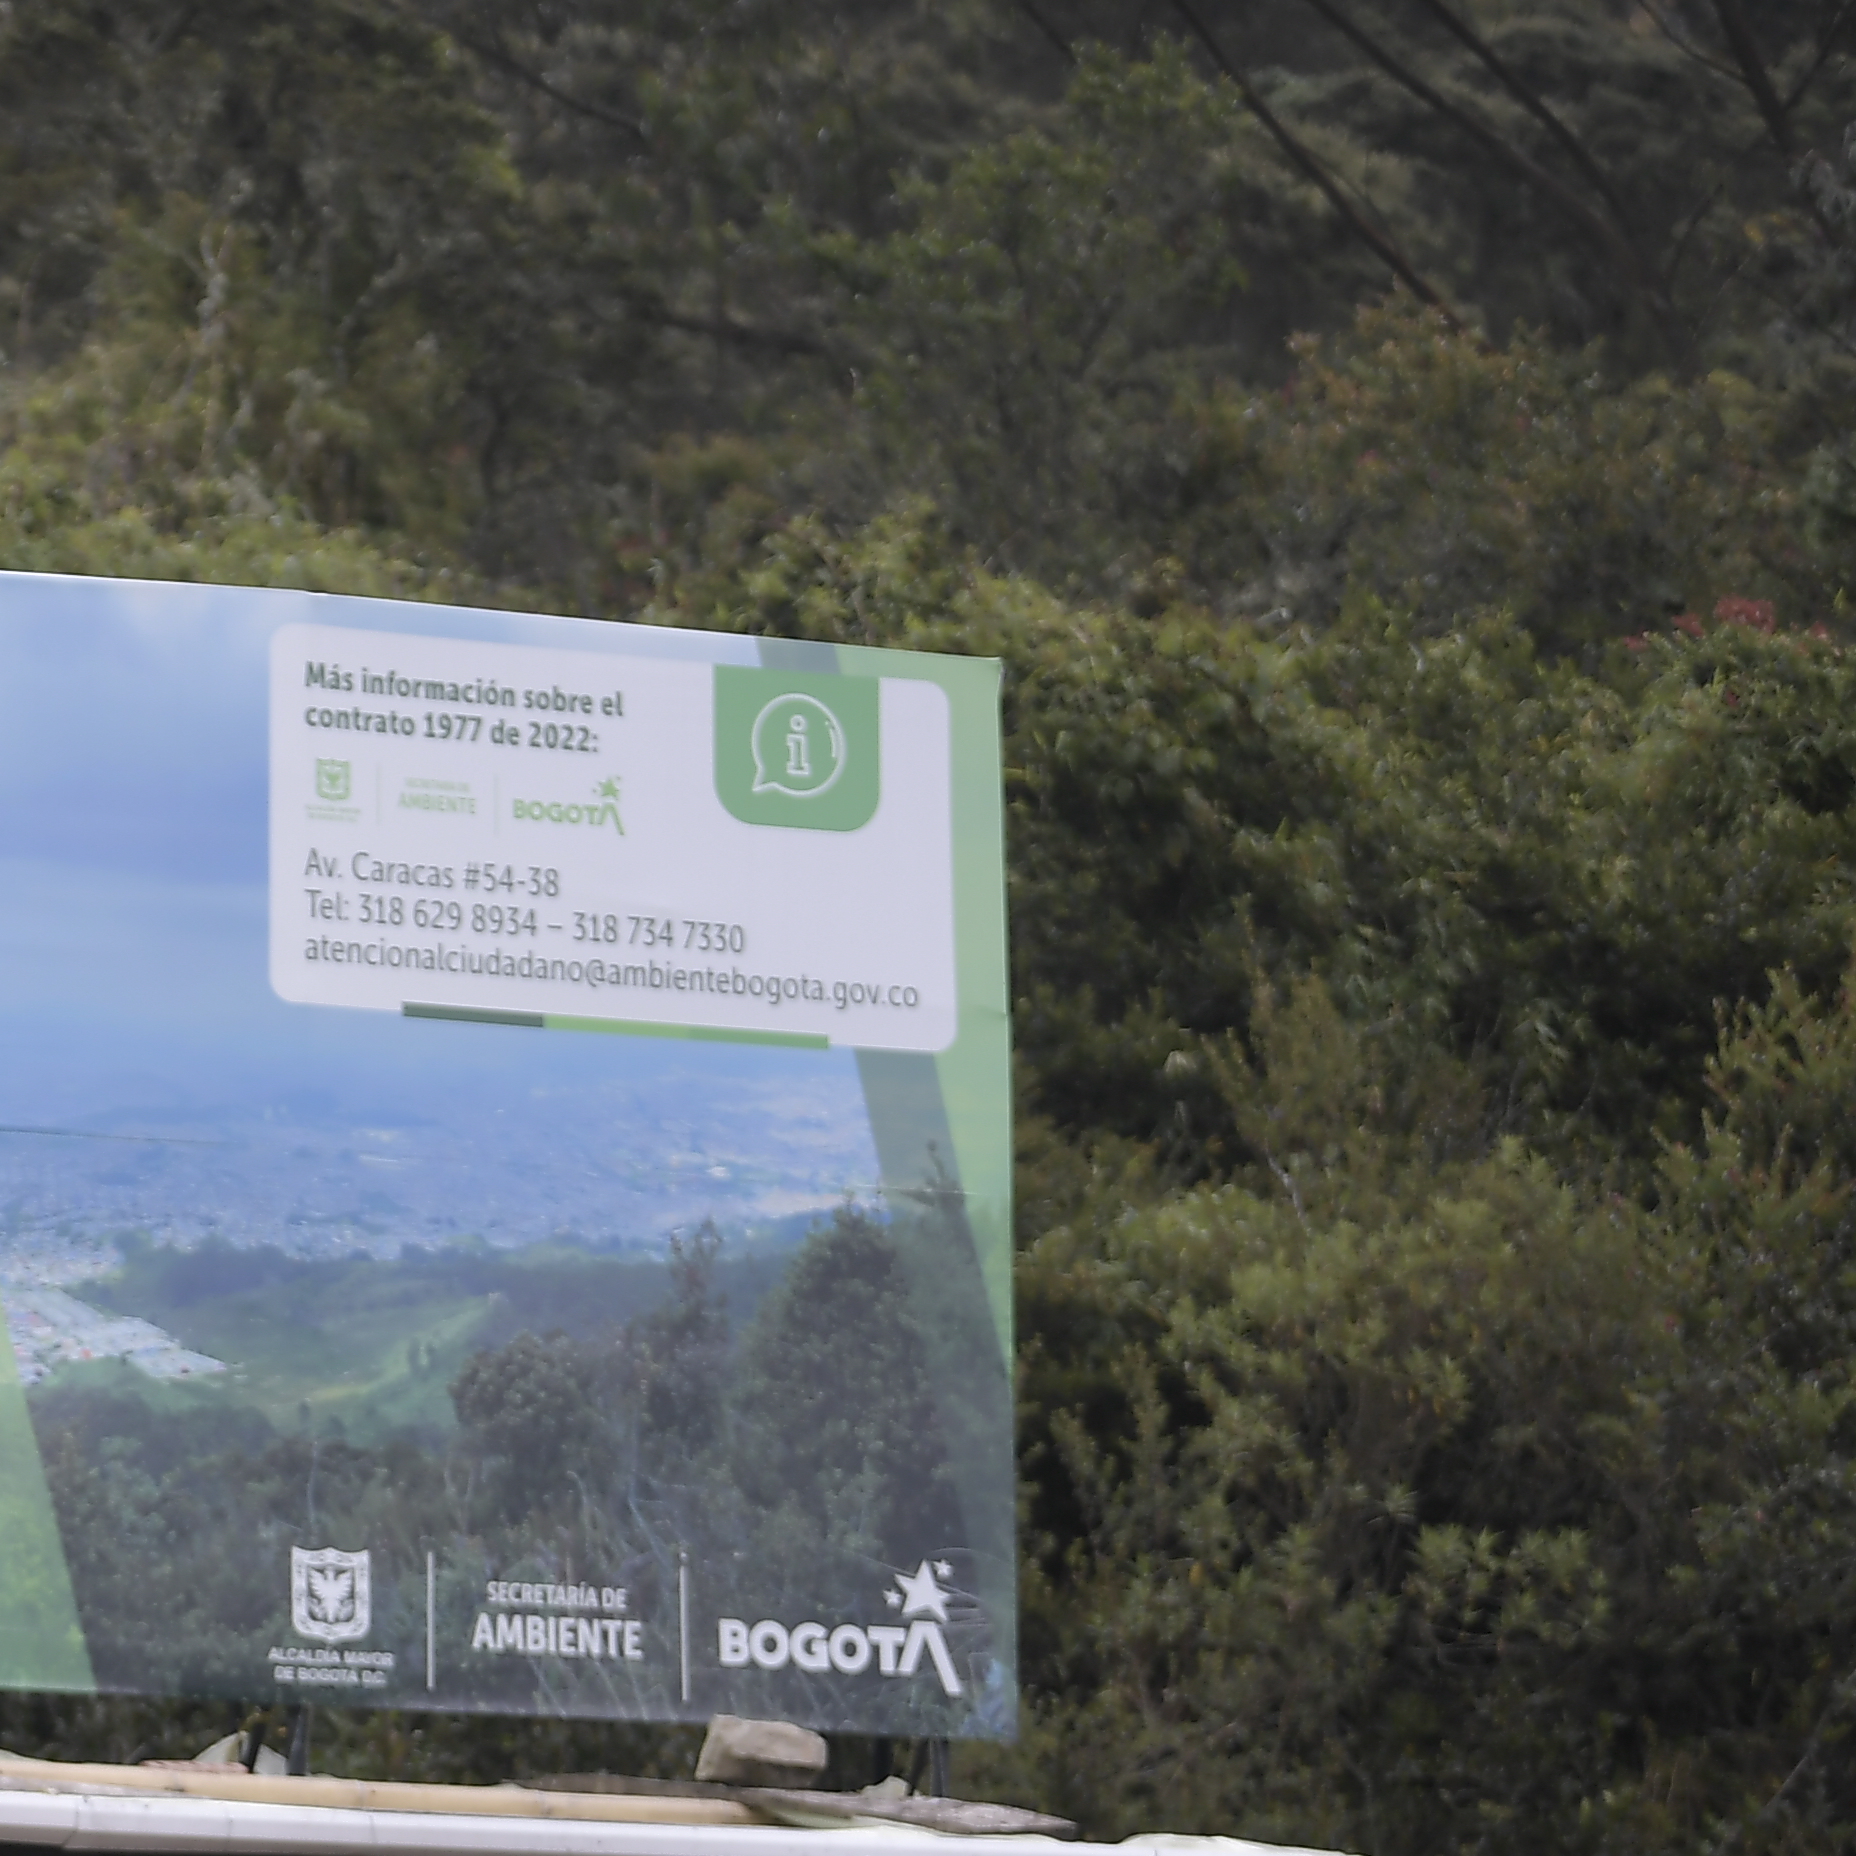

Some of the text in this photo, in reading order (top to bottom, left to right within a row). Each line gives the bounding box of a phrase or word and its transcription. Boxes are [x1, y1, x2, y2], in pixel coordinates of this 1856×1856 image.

[304, 661, 624, 717] Más información sobre el
[304, 706, 598, 753] contrato 1977 de 2022:
[304, 847, 560, 898] Av. Caracas #54-38
[304, 888, 350, 921] Tel:
[358, 893, 405, 927] 318
[412, 898, 464, 932] 629
[470, 903, 538, 937] 8934
[572, 911, 619, 945] 318
[626, 915, 675, 948] 734
[682, 920, 745, 954] 7330
[304, 934, 920, 1011] atencionalciudadano@ambientebogota.gov.co
[487, 1580, 629, 1611] SECRETARÍA DE
[471, 1612, 643, 1660] AMBIENTE
